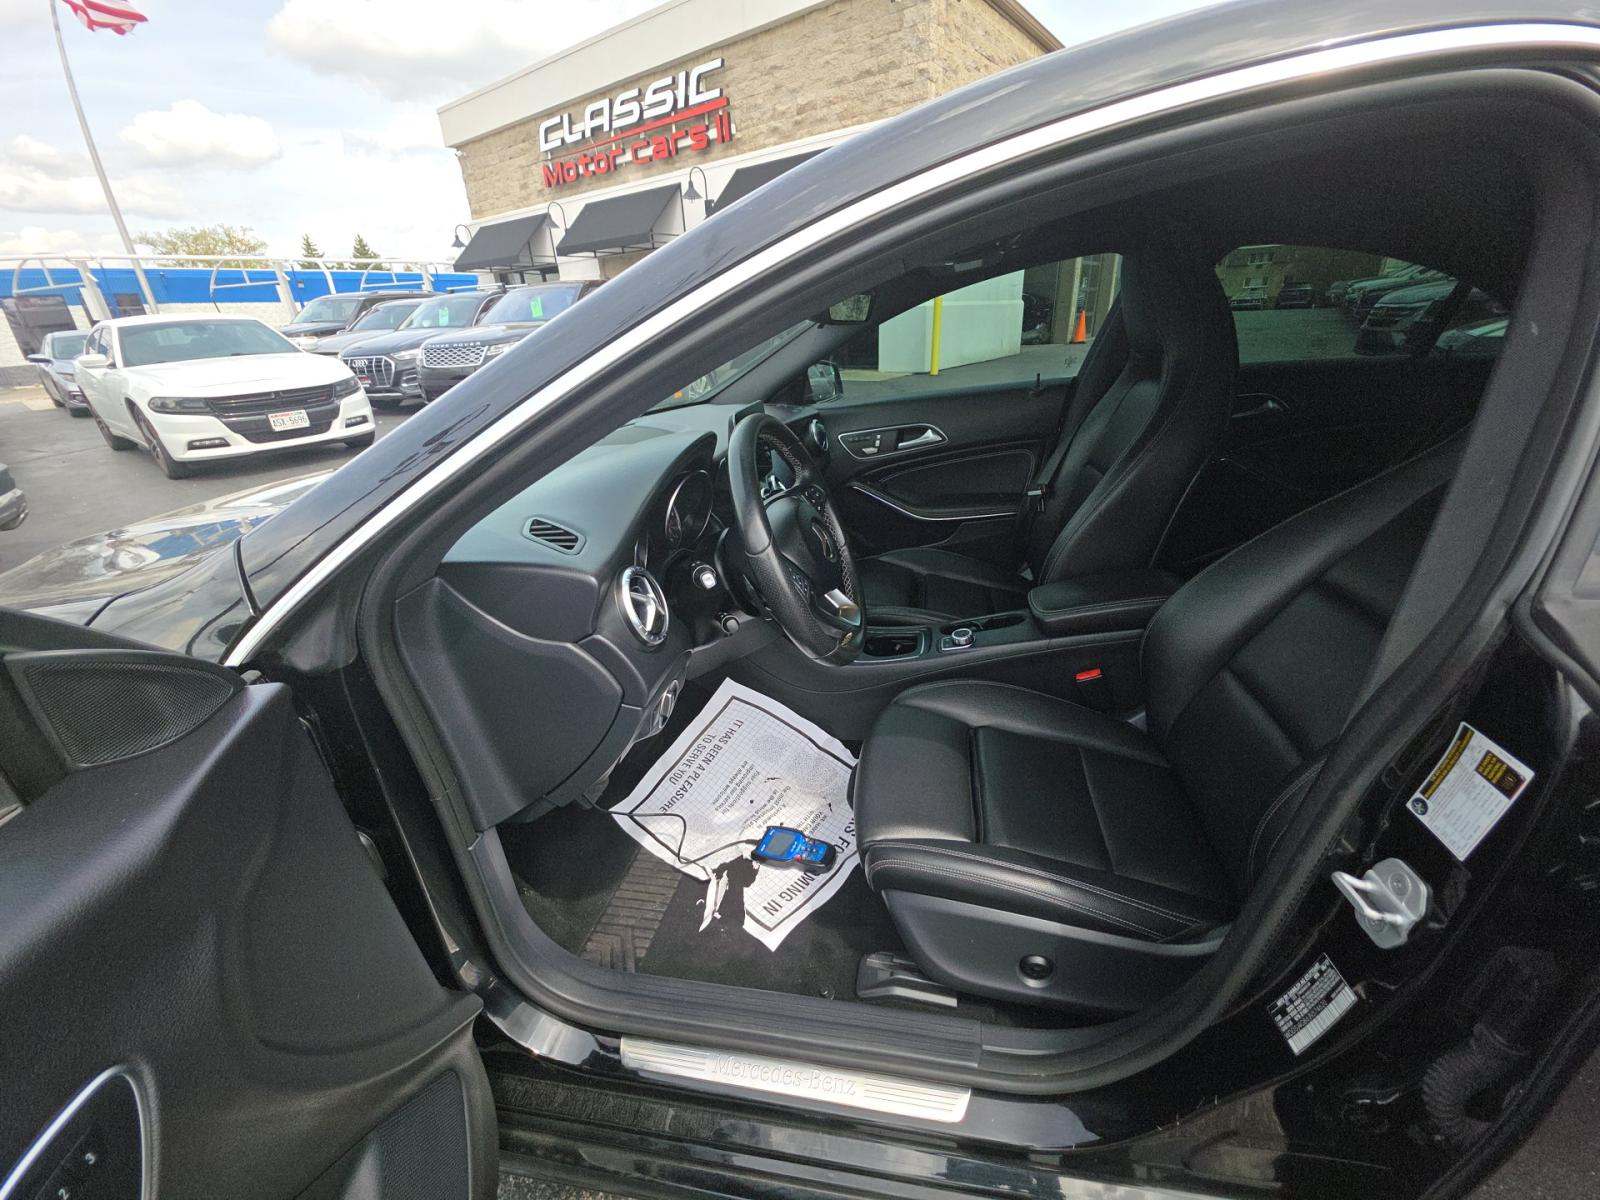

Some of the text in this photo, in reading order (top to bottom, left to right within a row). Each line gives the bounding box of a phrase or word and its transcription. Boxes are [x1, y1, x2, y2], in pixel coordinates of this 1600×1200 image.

[539, 57, 724, 153] CLASSIC
[542, 145, 624, 188] Motor
[719, 728, 736, 744] HAS
[669, 734, 717, 785] TO SERVE YOU
[696, 763, 706, 771] A
[702, 743, 723, 765] BEEN
[660, 770, 701, 814] PLEASURE
[762, 899, 783, 917] IN
